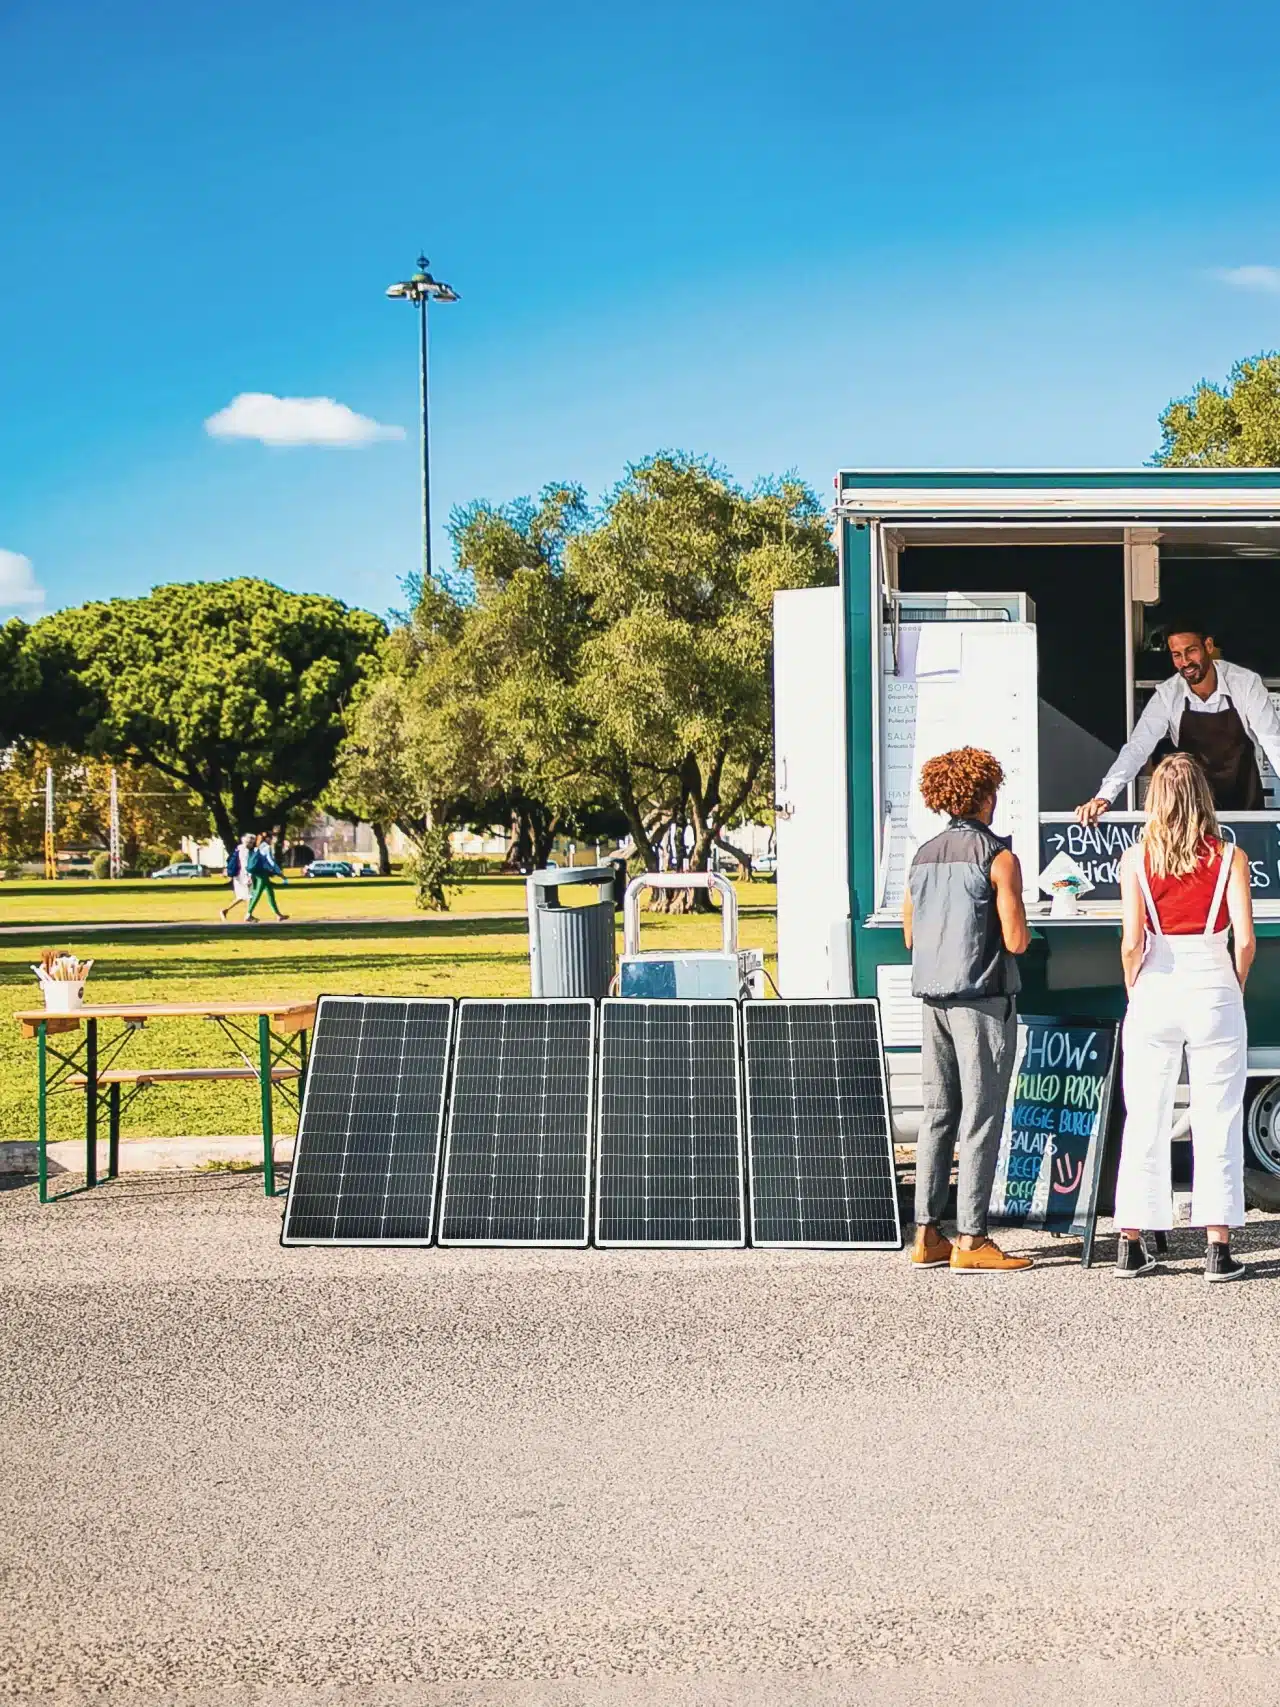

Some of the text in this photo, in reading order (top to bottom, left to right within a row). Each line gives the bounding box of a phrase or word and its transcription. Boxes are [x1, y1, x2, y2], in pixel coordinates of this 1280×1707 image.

[1067, 823, 1139, 855] BANAN
[1015, 1072, 1103, 1109] PULLED PORK
[1009, 1130, 1058, 1156] SALADS
